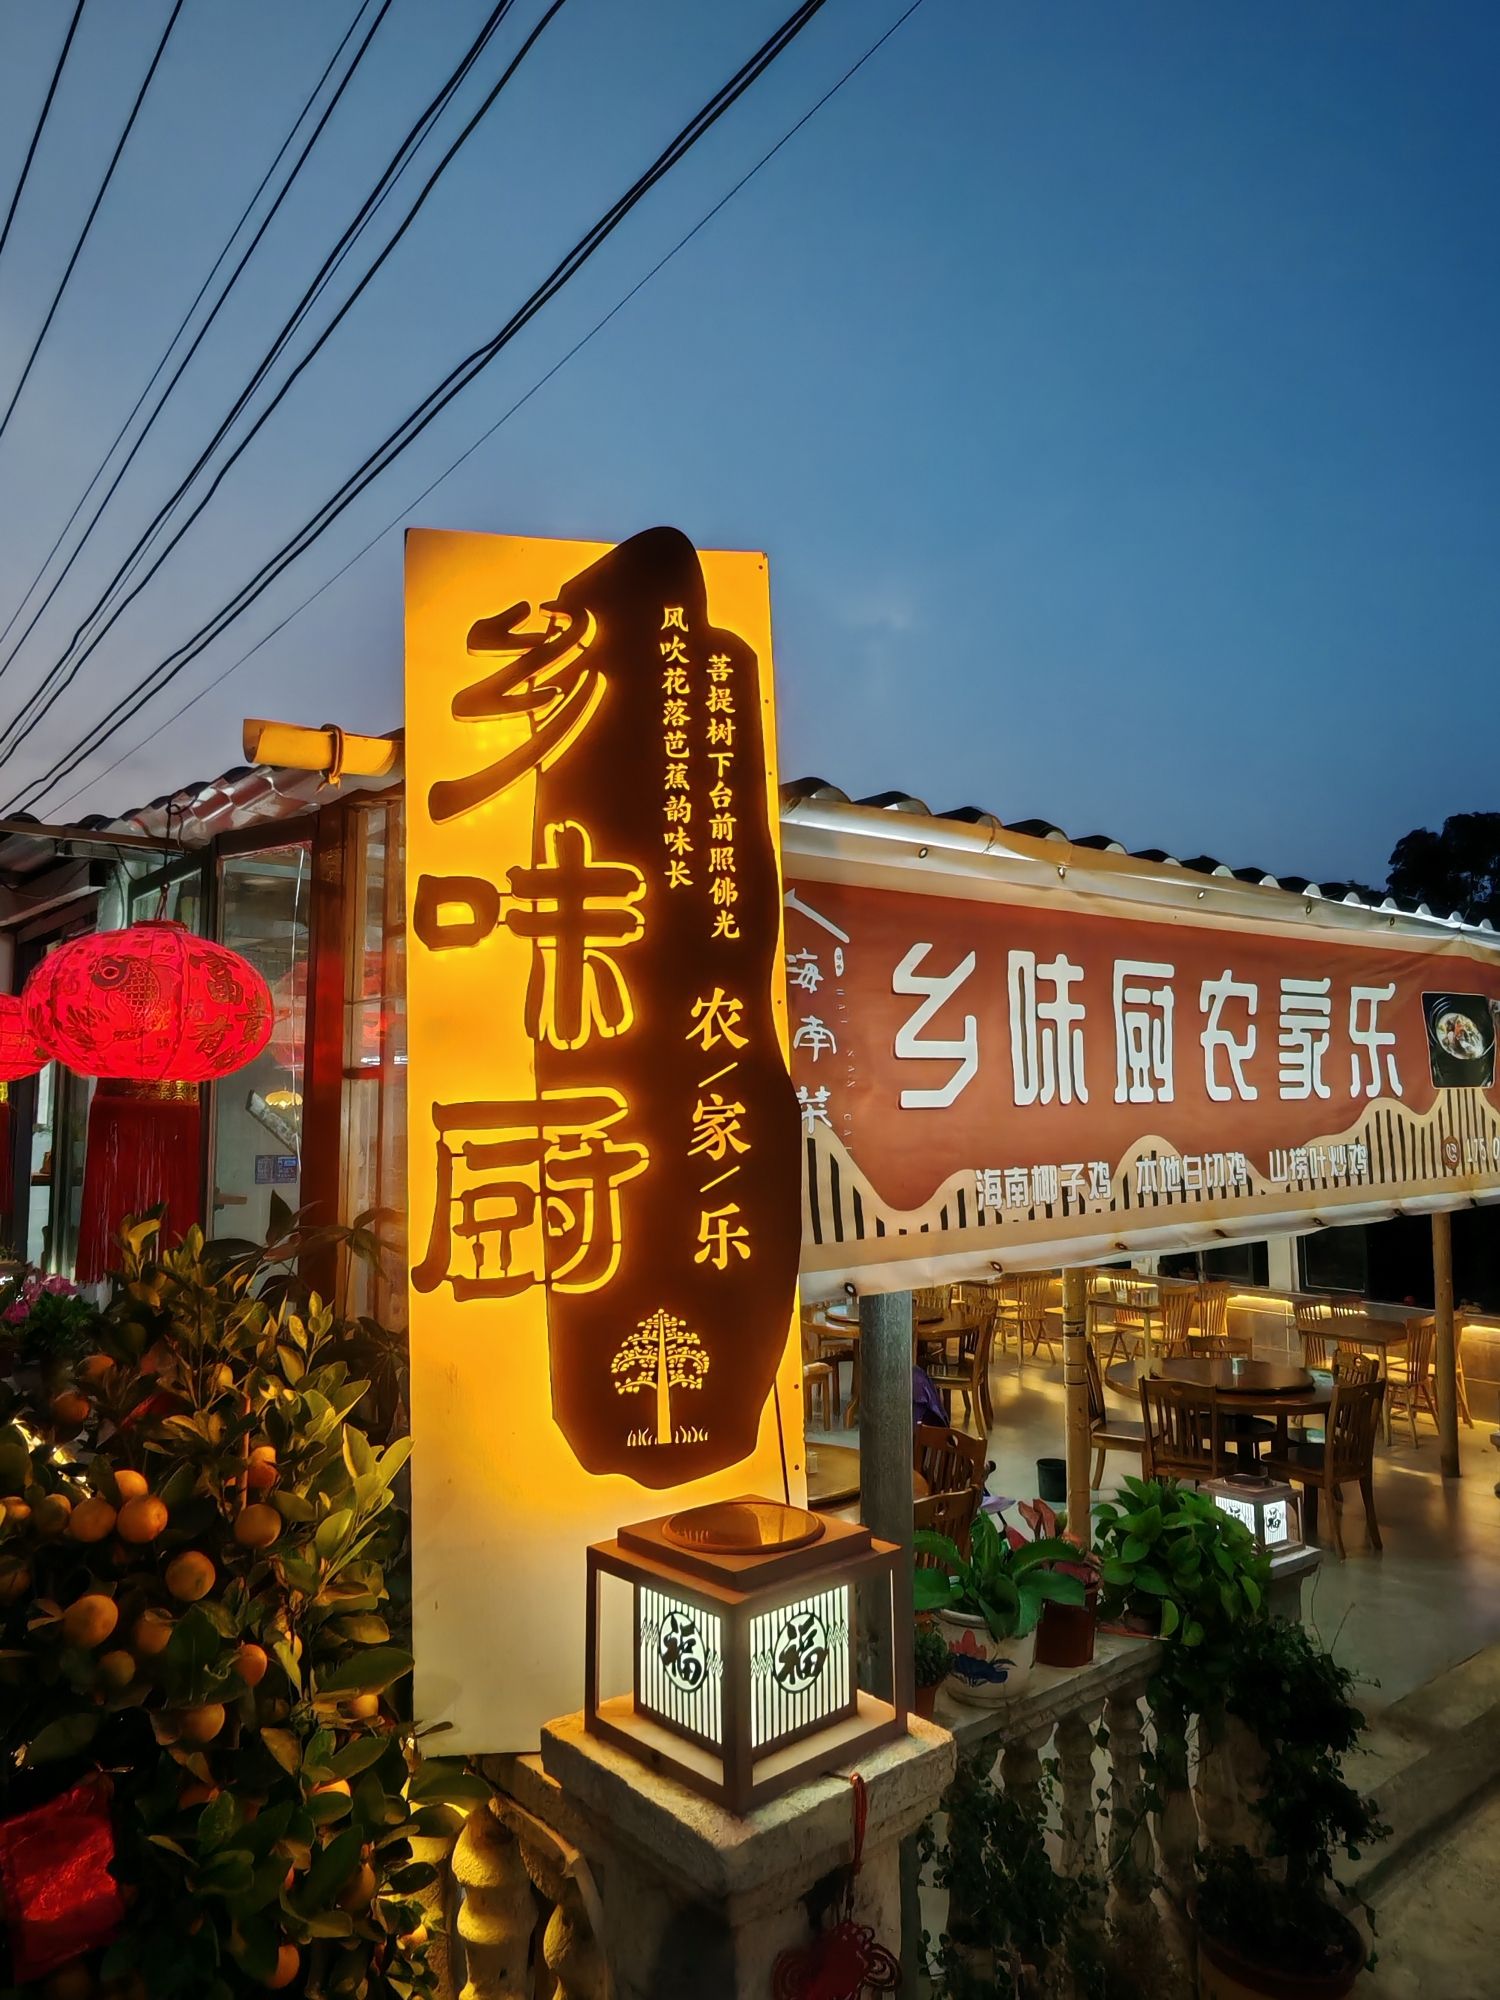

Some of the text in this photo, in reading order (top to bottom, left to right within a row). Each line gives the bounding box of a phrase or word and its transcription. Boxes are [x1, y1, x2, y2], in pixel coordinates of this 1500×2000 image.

[659, 606, 694, 889] 风吹花落芭蕉韵味长
[705, 654, 741, 940] 菩提树下台前照佛光
[411, 600, 650, 1301] 乡味厨
[892, 942, 1403, 1109] 乡味厨农家乐
[975, 1161, 1111, 1212] 海南椰子鸡
[1136, 1152, 1247, 1194] 本地白切鸡
